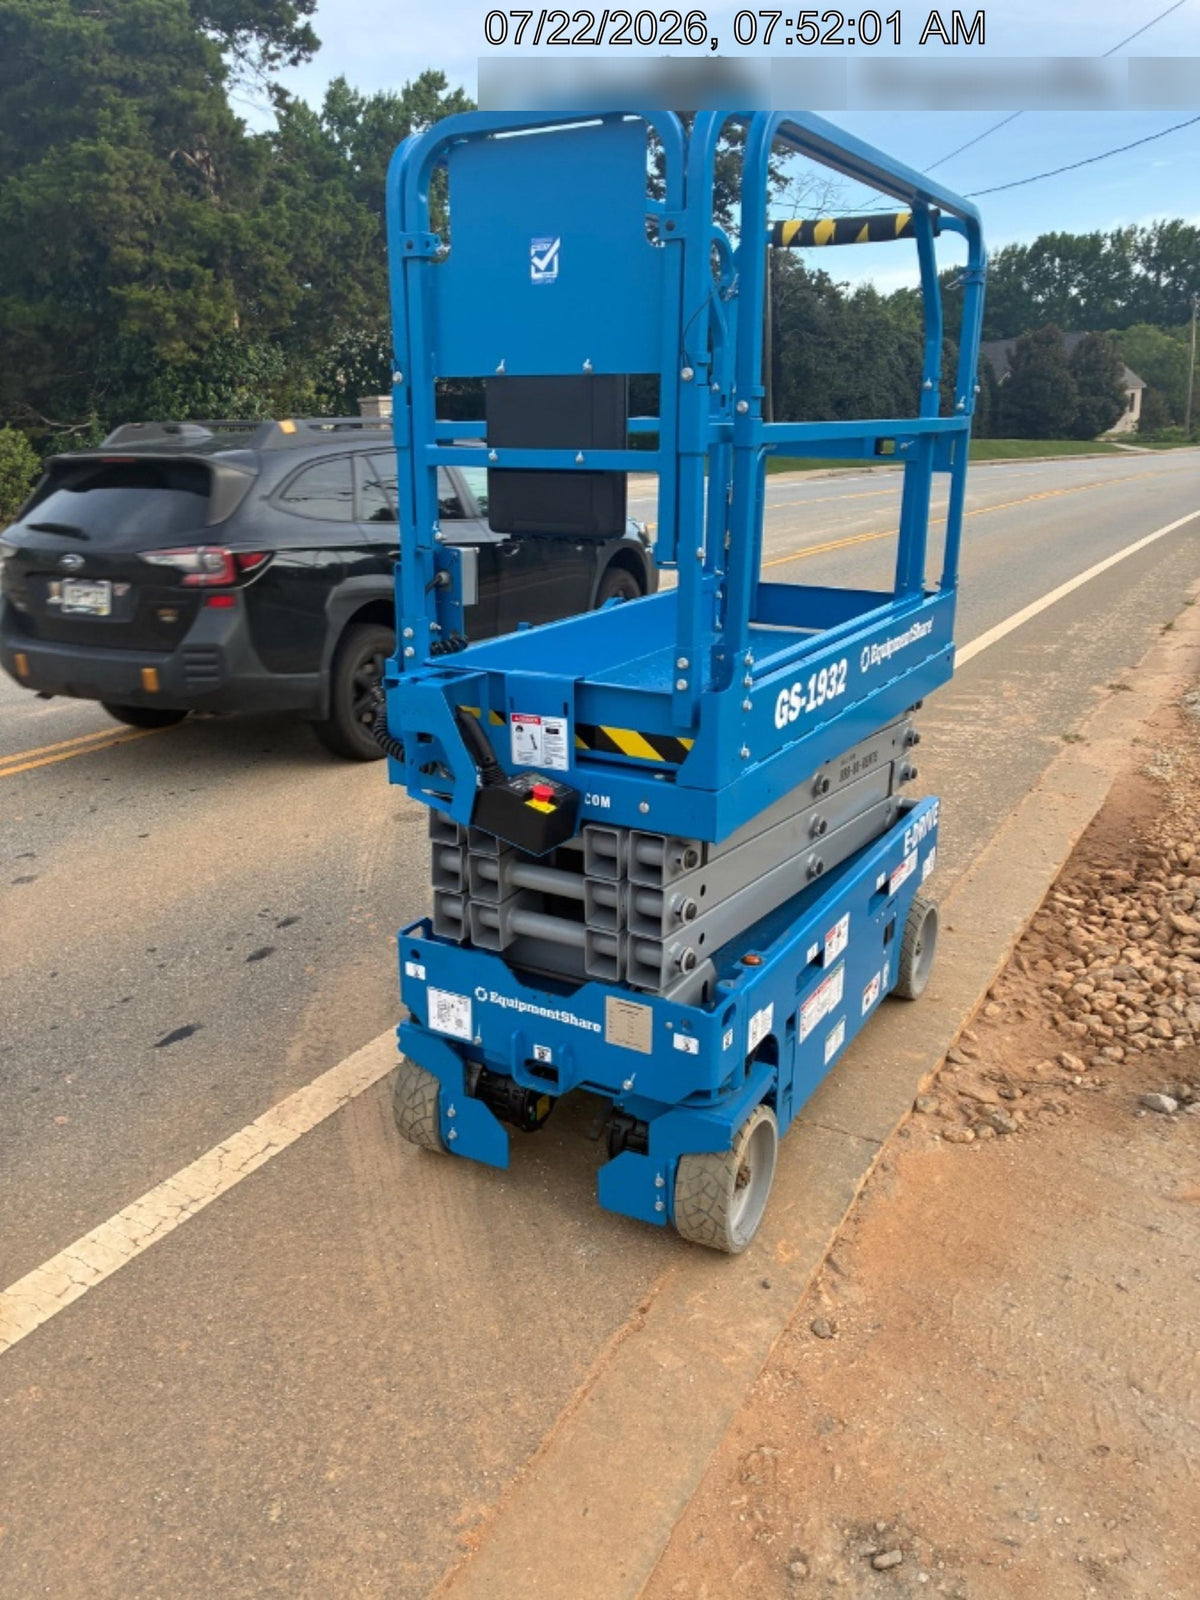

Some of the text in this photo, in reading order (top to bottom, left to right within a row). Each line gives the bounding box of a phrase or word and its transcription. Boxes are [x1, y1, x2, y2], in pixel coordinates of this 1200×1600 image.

[870, 619, 933, 666] EquipmentShare
[774, 658, 848, 730] GS-1932
[490, 991, 602, 1033] EquipmentShare
